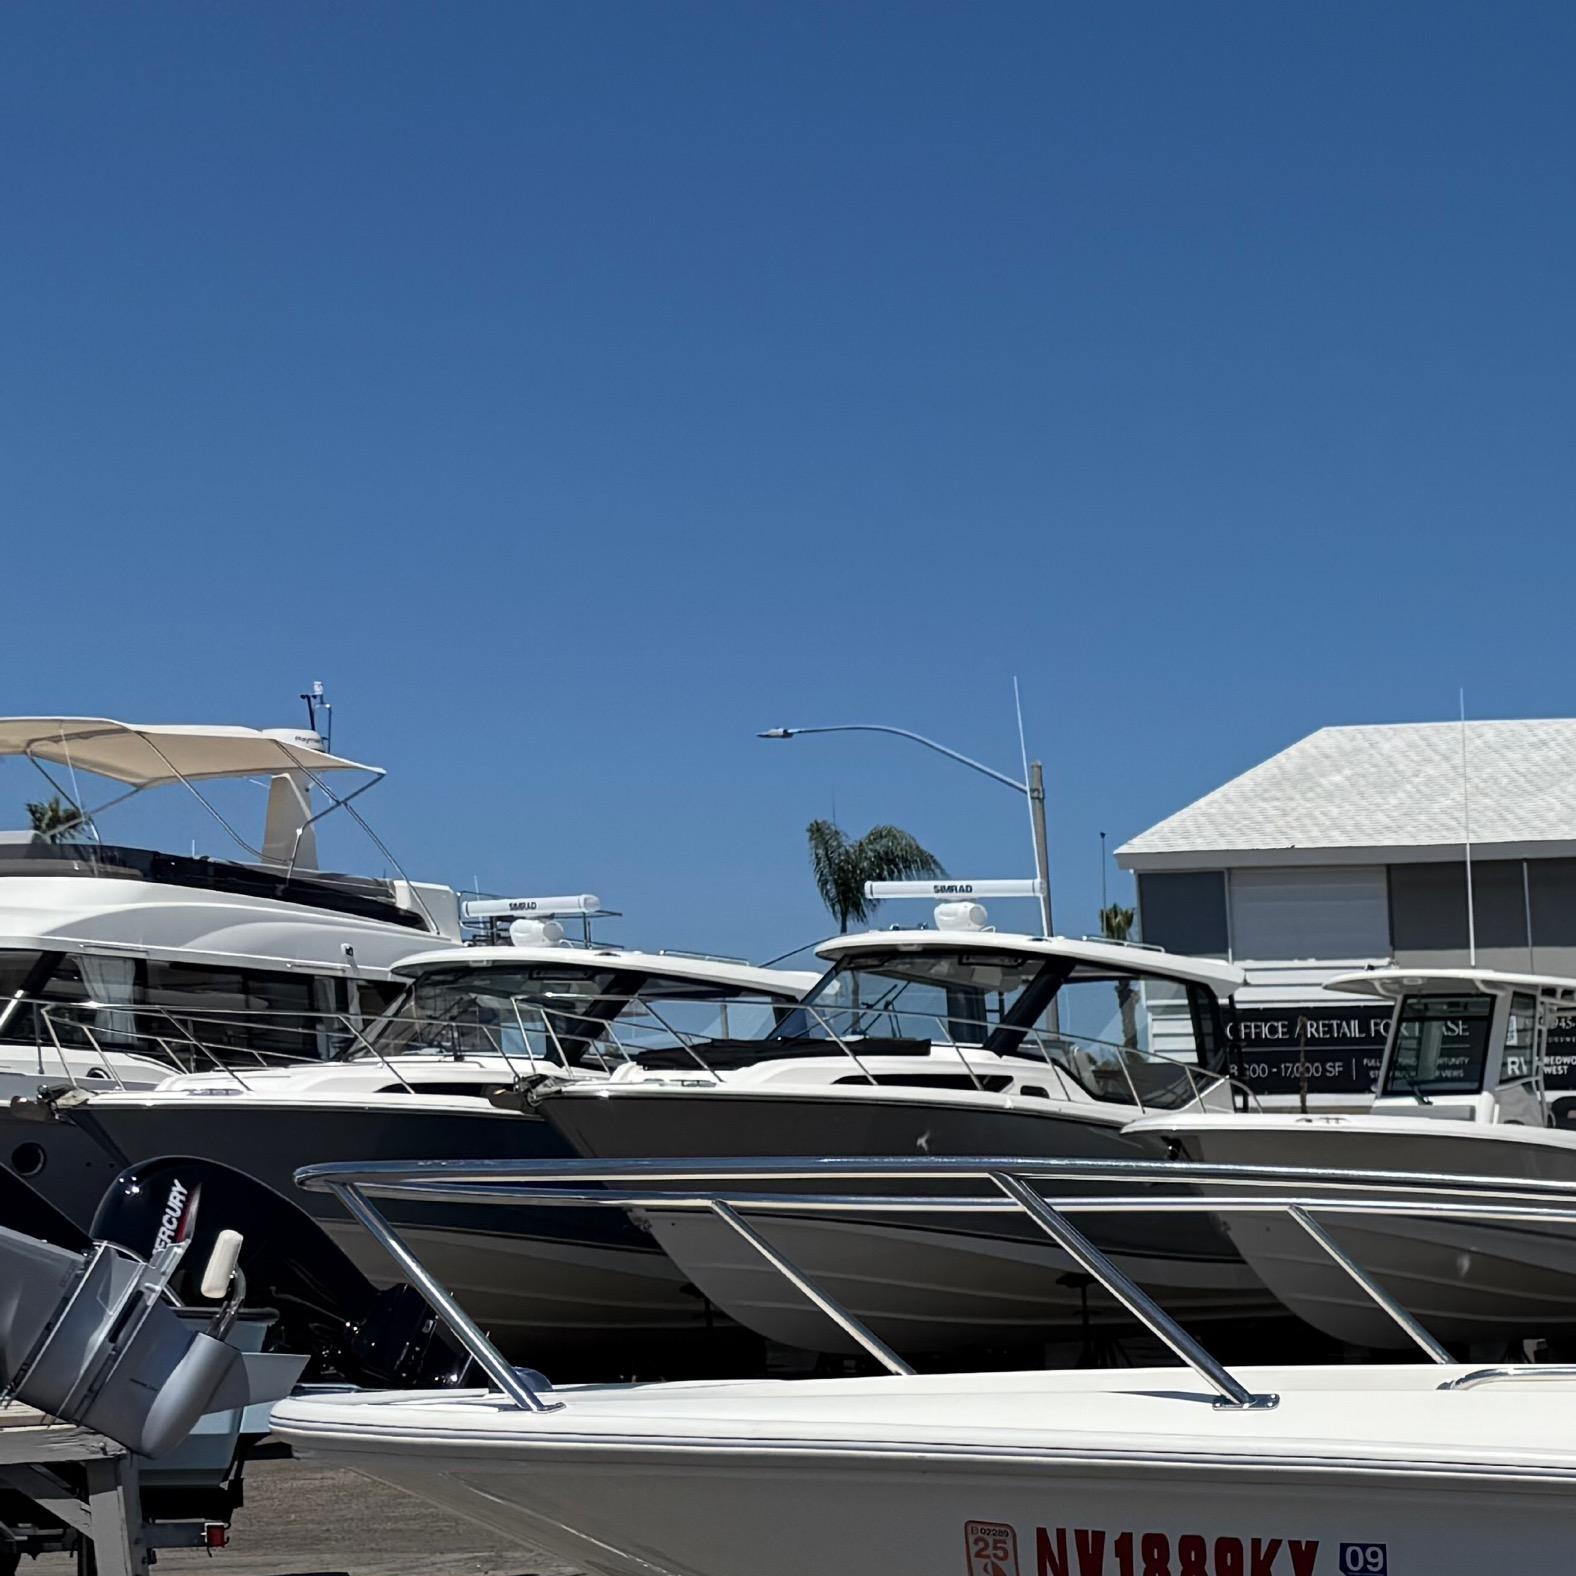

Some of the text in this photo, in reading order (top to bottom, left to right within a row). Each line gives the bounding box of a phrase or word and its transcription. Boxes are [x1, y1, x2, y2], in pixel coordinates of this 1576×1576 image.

[1307, 1019, 1367, 1038] RETAIL
[1325, 1061, 1344, 1077] SF
[151, 1178, 188, 1253] ERCURY
[973, 1535, 1010, 1562] 25
[1345, 1545, 1385, 1573] 09
